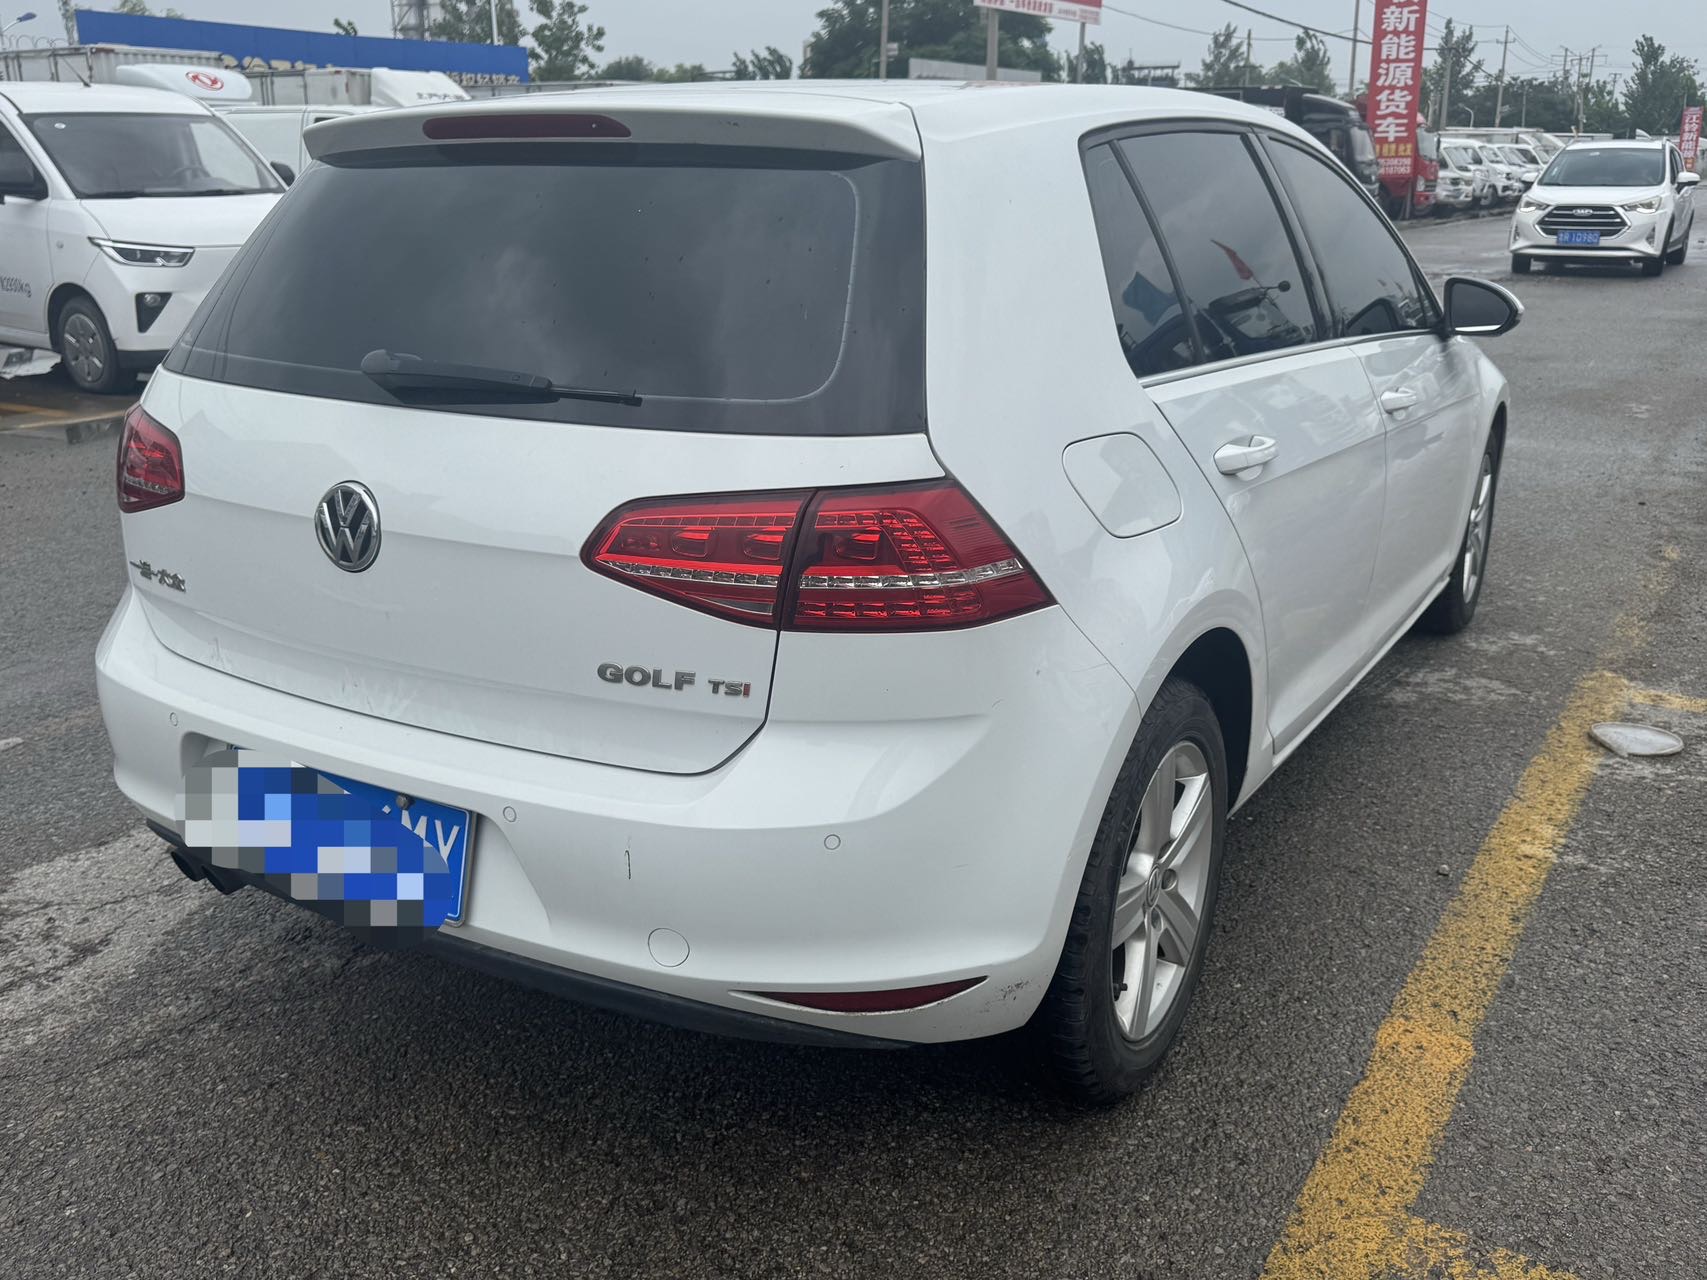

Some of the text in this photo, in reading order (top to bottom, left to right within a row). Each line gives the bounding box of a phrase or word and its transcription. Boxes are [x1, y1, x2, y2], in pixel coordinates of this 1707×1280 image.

[1374, 0, 1420, 142] 新能源货车
[597, 661, 752, 698] GOLF TSI
